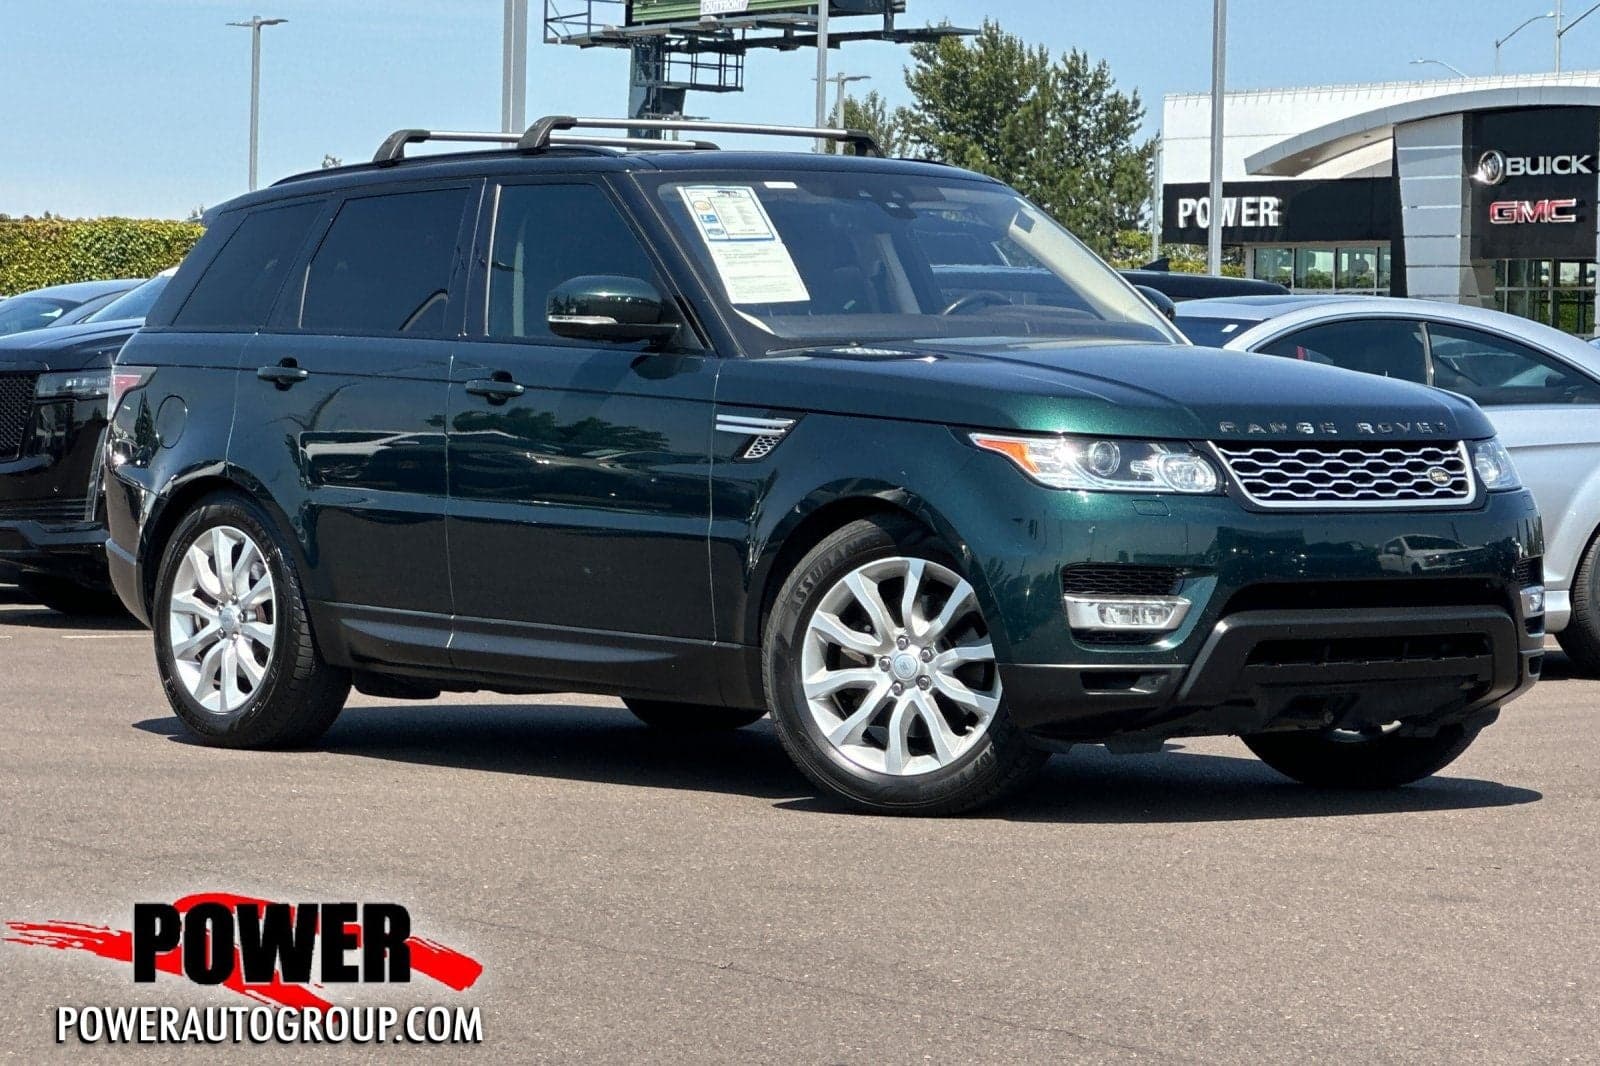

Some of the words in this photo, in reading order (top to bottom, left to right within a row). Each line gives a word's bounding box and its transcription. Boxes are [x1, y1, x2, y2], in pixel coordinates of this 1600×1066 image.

[1506, 155, 1592, 176] BUICK
[1178, 196, 1280, 229] POWER
[1489, 199, 1577, 224] GMC
[1219, 421, 1338, 434] RANGE
[789, 537, 881, 616] ASSURAN
